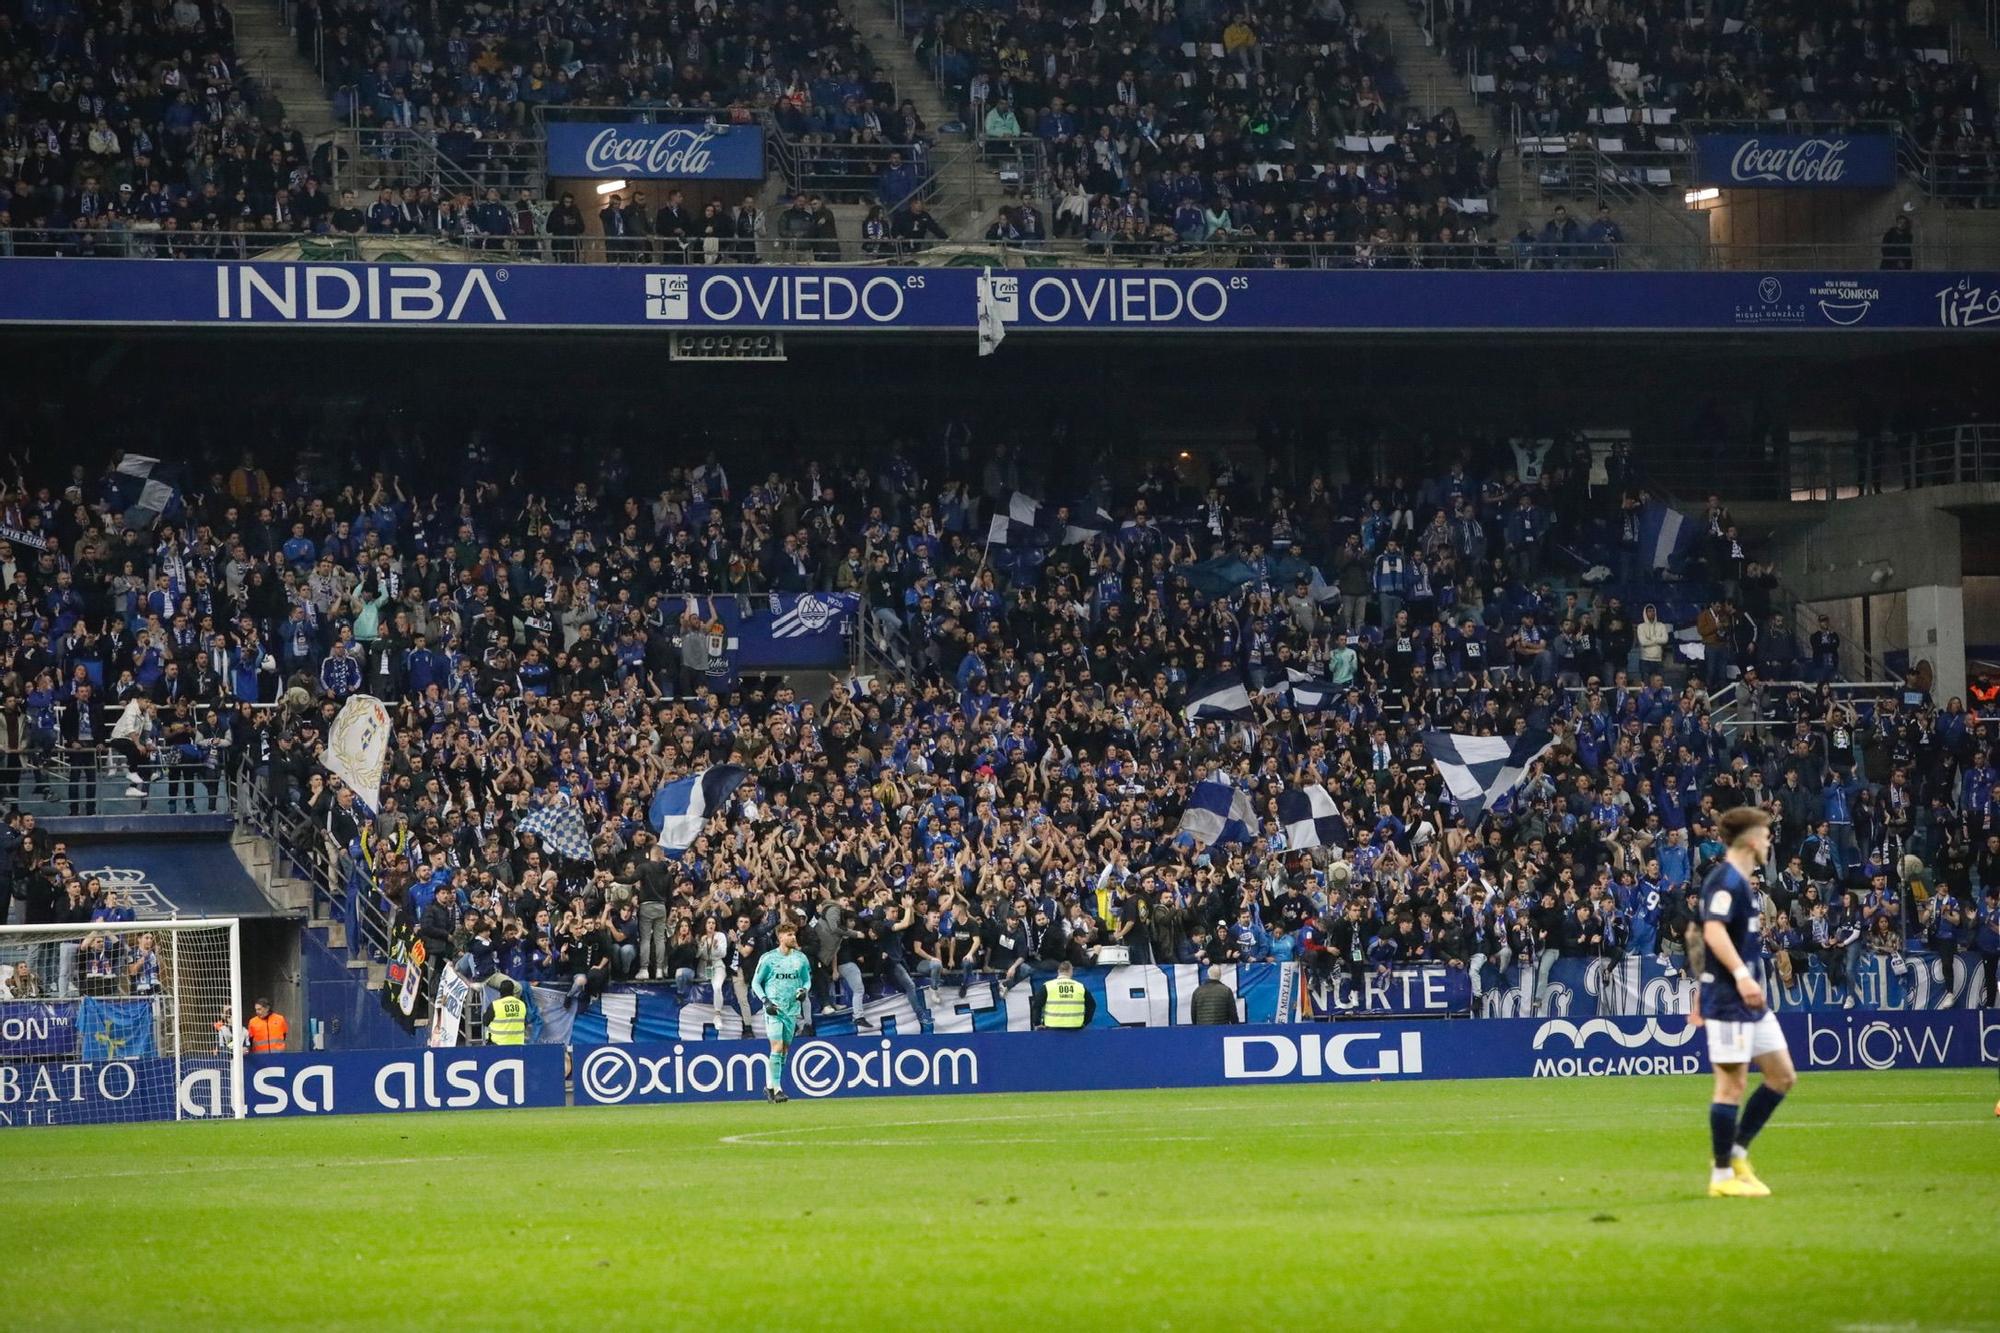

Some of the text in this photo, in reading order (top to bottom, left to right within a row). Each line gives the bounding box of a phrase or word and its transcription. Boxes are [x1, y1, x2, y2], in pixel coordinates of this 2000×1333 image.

[585, 127, 715, 174] Coca-Cola
[1731, 138, 1850, 183] Coca-Cola
[1837, 287, 1879, 300] SONRISA
[1646, 890, 1661, 911] 9
[775, 972, 799, 980] DIGI
[1283, 966, 1291, 988] LEAL
[1223, 1031, 1423, 1079] DIGI
[1807, 1010, 1954, 1070] biow
[374, 1050, 525, 1109] alsa
[581, 1044, 771, 1104] exiom
[790, 1039, 978, 1097] exiom
